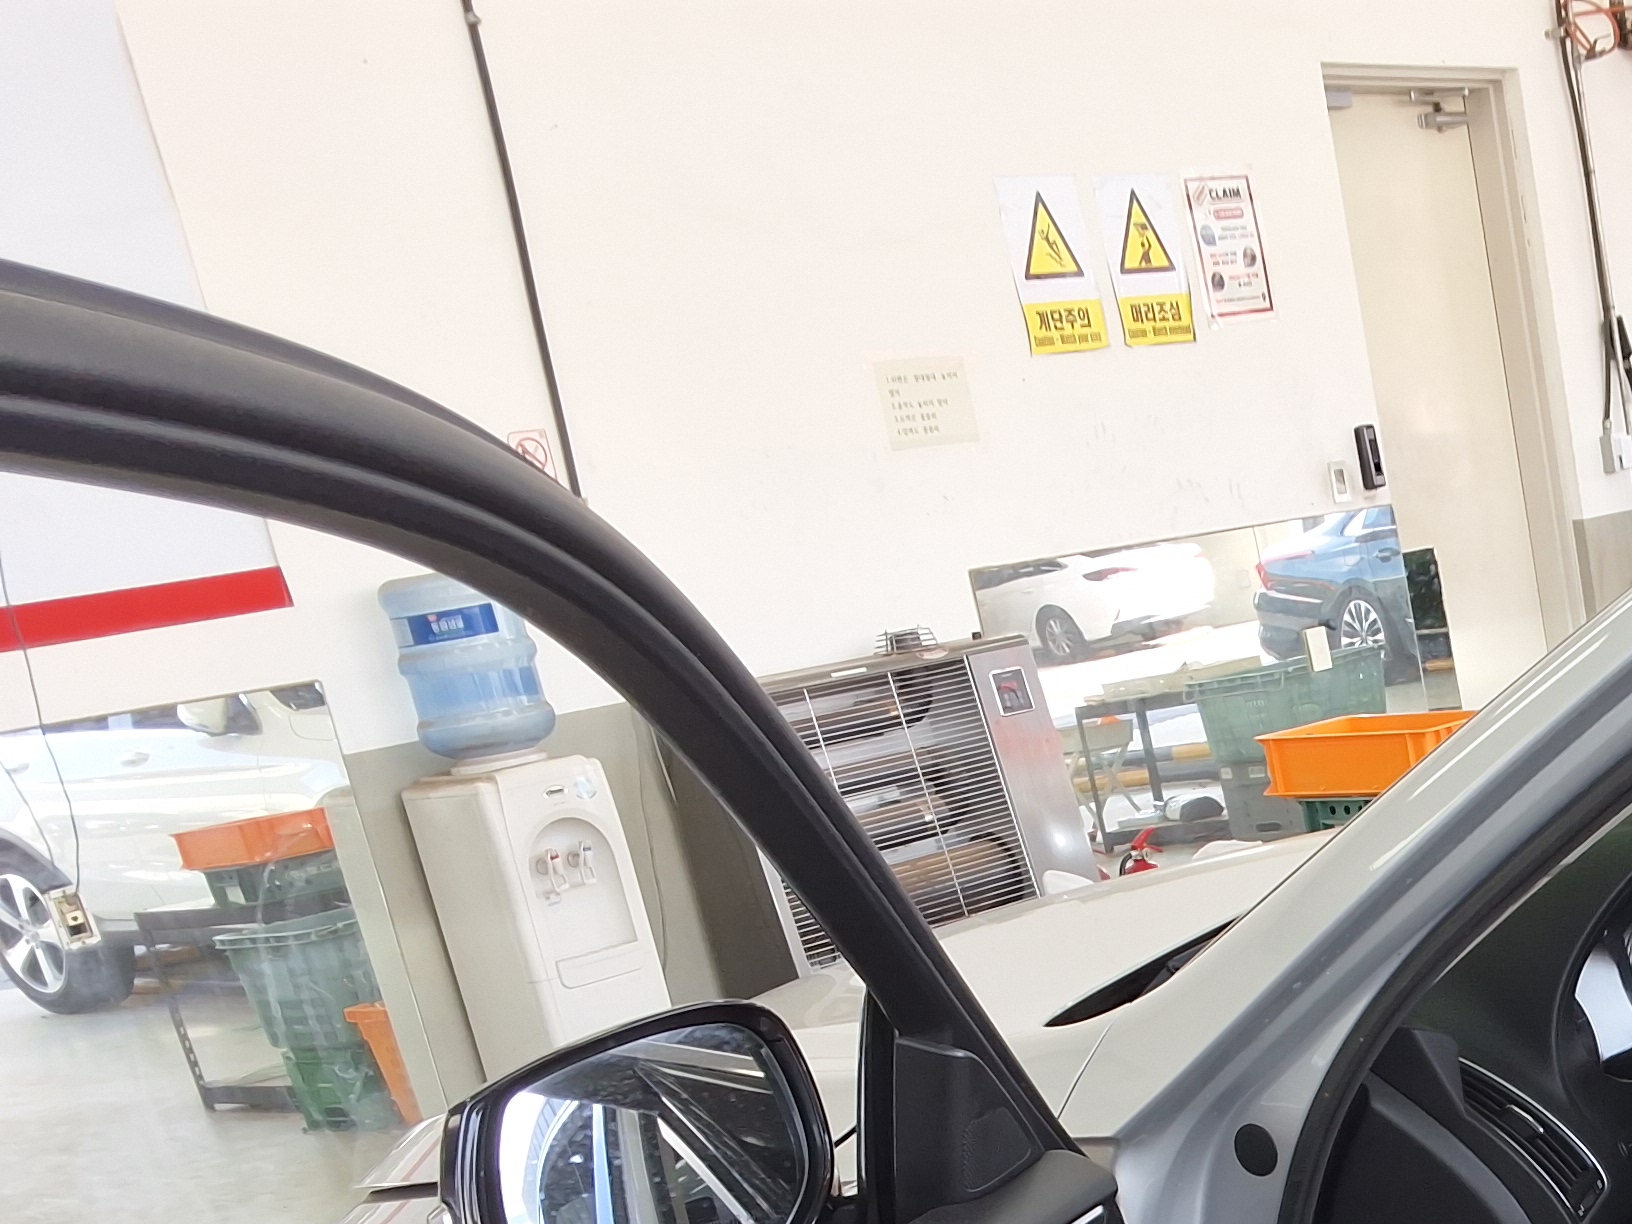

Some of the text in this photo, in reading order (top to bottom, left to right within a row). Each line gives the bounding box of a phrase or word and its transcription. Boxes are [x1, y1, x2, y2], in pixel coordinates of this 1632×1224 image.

[1208, 186, 1242, 200] CLAIM
[1036, 307, 1091, 332] 계단주의
[1129, 300, 1182, 325] 머리조심
